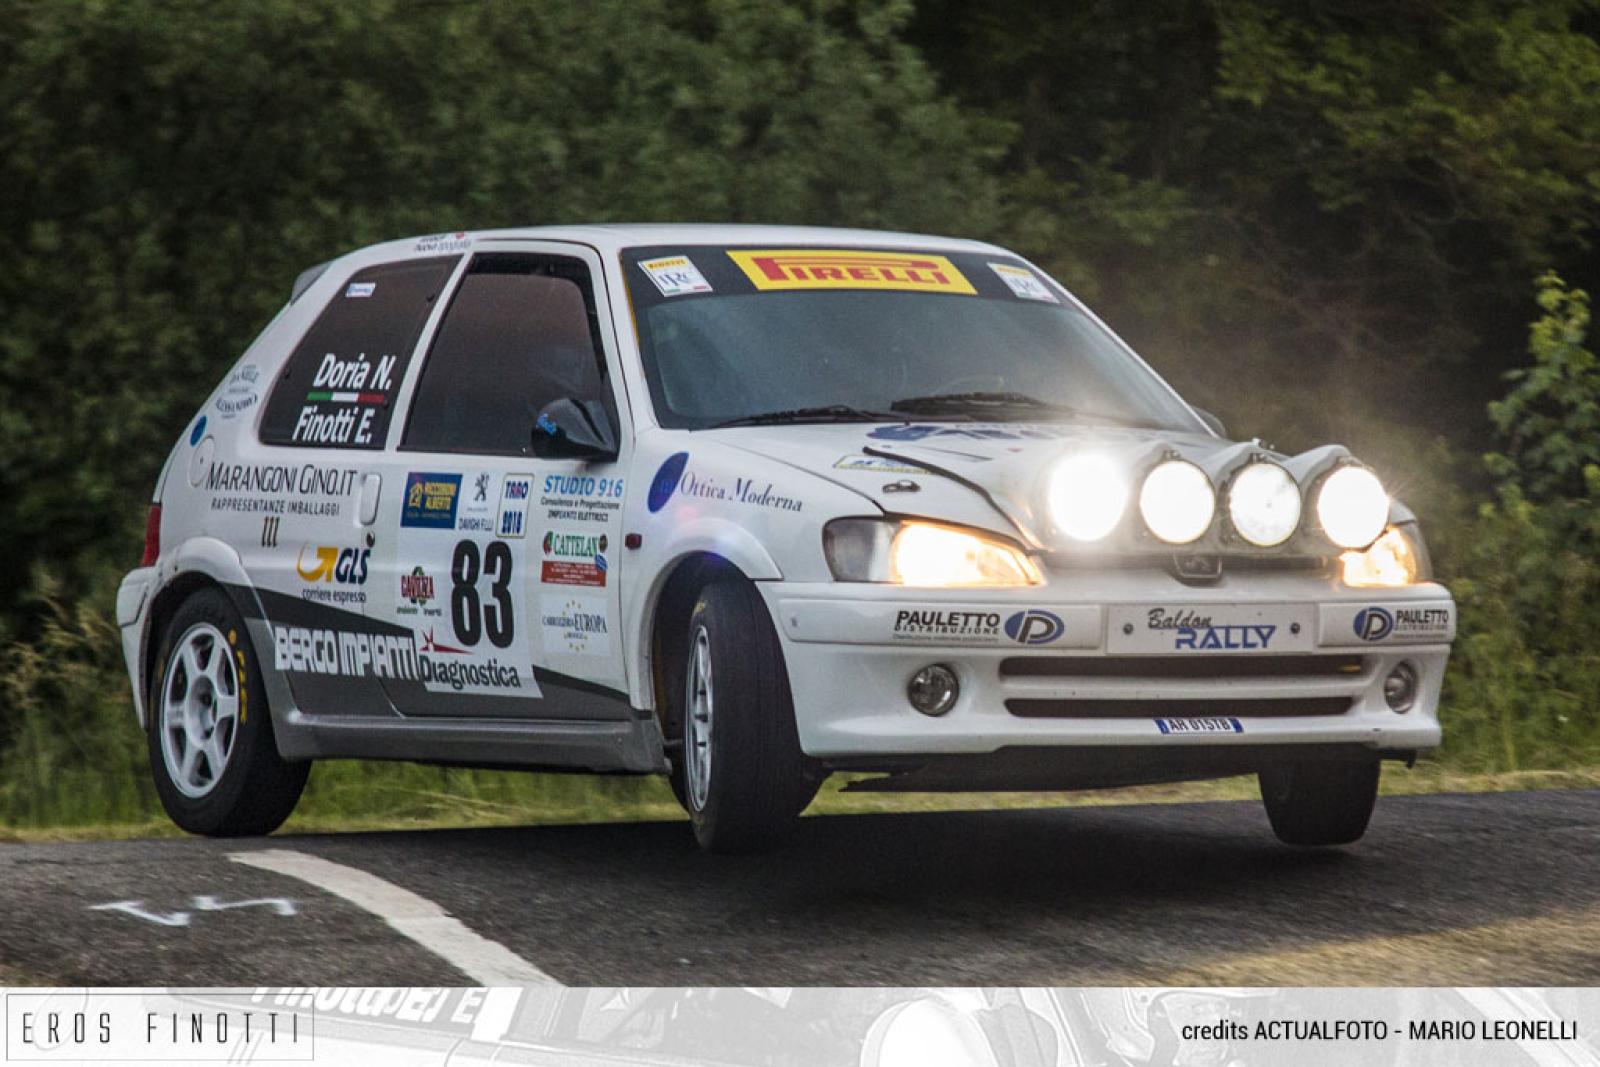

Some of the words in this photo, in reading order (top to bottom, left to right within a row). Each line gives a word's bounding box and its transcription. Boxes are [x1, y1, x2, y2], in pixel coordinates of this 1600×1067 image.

[751, 256, 951, 284] PIRELLI
[313, 353, 371, 389] Doria
[370, 355, 396, 390] N.
[293, 405, 356, 442] Finotti
[354, 409, 376, 443] E.
[205, 462, 298, 493] MARANGONI
[544, 475, 595, 496] STUDIO
[598, 478, 624, 497] 916
[680, 471, 726, 500] Ottica
[729, 477, 803, 512] Moderna
[211, 497, 285, 513] RAPPRESENTANZE
[287, 500, 340, 516] IMBALLAGGI
[554, 534, 599, 557] CATTELAN
[335, 547, 371, 585] GLS
[302, 588, 332, 600] corriere
[333, 590, 366, 603] espresso
[451, 539, 514, 649] 83
[896, 610, 1000, 627] PAULETTO
[1148, 608, 1212, 630] Baldon
[1396, 609, 1449, 623] PAULETTO
[894, 626, 999, 635] DISTRIBUZIONE
[1175, 625, 1277, 649] RALLY
[274, 626, 338, 674] BERGO
[338, 632, 421, 681] IMPIANTI
[419, 655, 521, 691] Diagnostica
